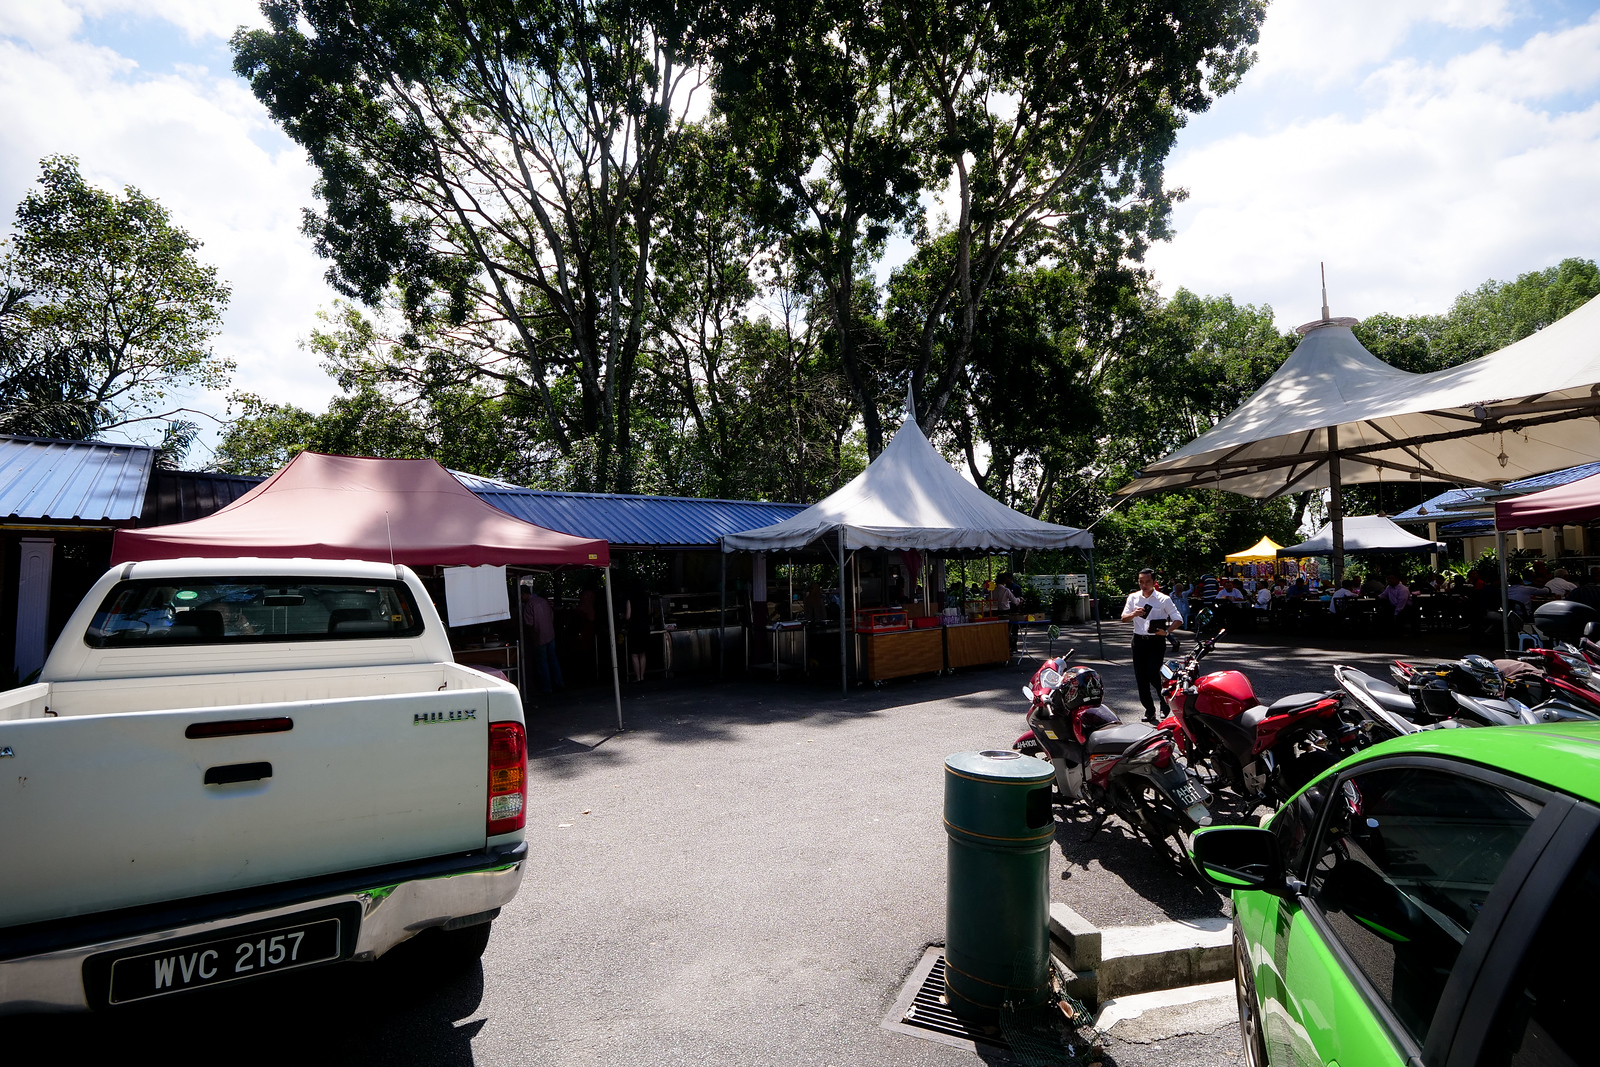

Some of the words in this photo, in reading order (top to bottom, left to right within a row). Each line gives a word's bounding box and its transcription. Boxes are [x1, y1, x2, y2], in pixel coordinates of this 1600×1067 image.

[414, 709, 476, 725] HILUX
[1176, 783, 1196, 798] AHH
[1181, 791, 1202, 805] 1011
[154, 949, 219, 989] WVC
[235, 931, 305, 973] 2157
